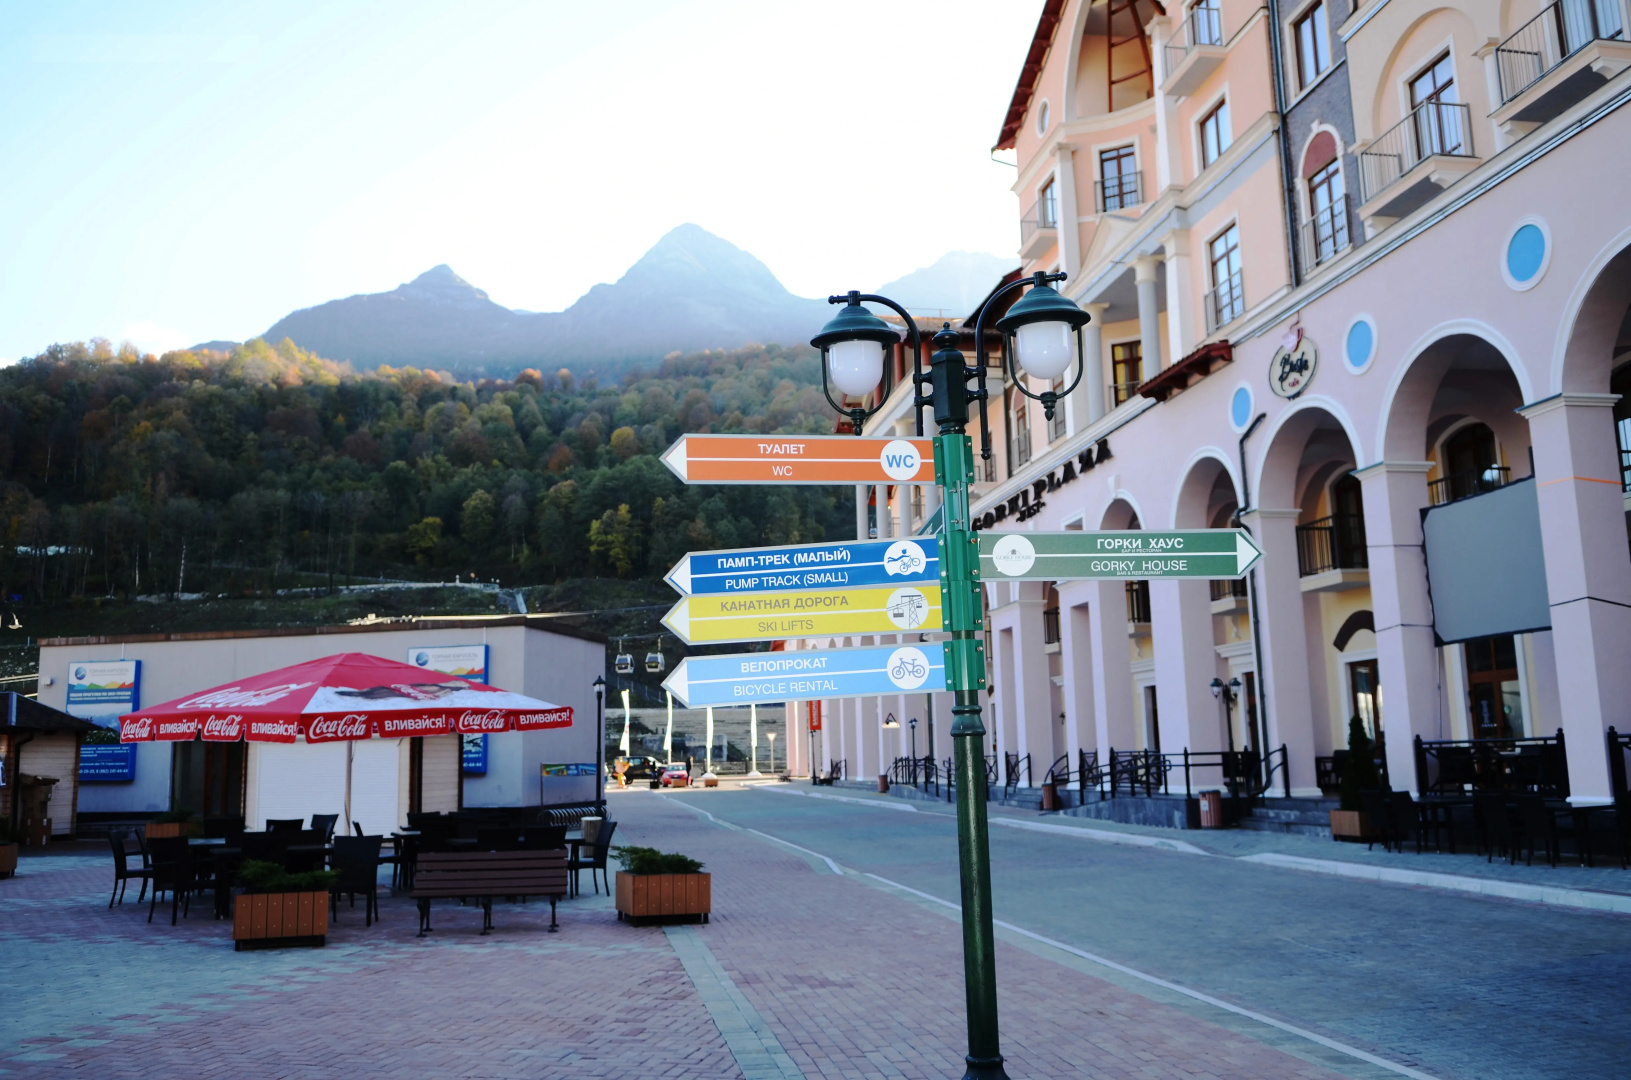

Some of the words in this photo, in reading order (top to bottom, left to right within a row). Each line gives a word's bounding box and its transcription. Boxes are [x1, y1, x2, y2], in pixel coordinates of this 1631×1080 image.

[758, 443, 805, 455] ТУАЛЕТ
[886, 454, 915, 468] WC
[1032, 438, 1114, 501] PLAZA
[772, 465, 793, 476] WC
[1097, 538, 1141, 549] ГОРКИ
[1149, 538, 1184, 549] ХАУС
[717, 554, 790, 569] ПАМП-ТРЕК
[793, 549, 851, 566] (МАЛЫЙ)
[1091, 560, 1135, 571] GORKY
[1142, 560, 1188, 571] HOUSE
[725, 577, 759, 590] PUMP
[761, 575, 801, 588] TRACK
[803, 572, 849, 586] (SMALL)
[720, 597, 791, 612] КАНАТНАЯ
[793, 595, 849, 610] ДОРОГА
[758, 620, 778, 632] SKI
[780, 619, 814, 631] LIFTS
[740, 657, 828, 673] ВЕЛОПРОКАТ
[734, 682, 786, 696] BICYCLE
[791, 679, 838, 692] RENTAL
[384, 714, 446, 732] вливайся!
[459, 709, 508, 730] Coca-Cola
[519, 709, 570, 725] вливайся!
[120, 717, 152, 739] Coca-Cola
[159, 718, 198, 735] вливайся!
[204, 715, 243, 737] Coca-Cola
[251, 720, 297, 736] вливайся!
[309, 714, 368, 740] Coca-Cola
